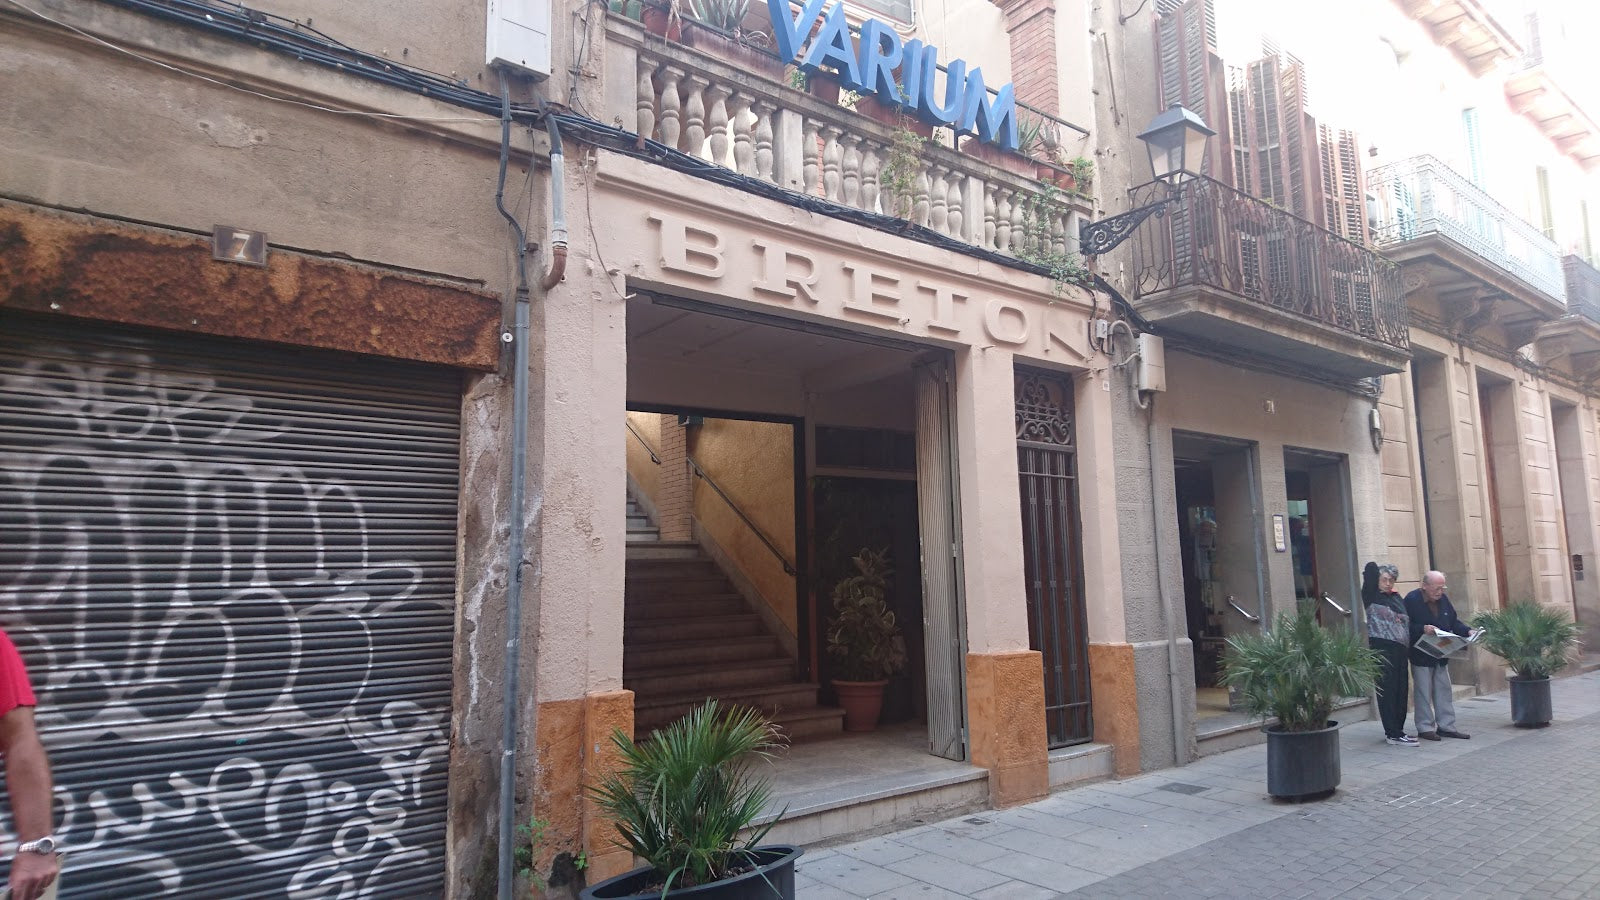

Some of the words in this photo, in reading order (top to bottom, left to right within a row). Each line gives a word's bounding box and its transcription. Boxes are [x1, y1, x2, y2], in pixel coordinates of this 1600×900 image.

[767, 0, 1019, 149] VARIUM
[232, 232, 250, 261] 7
[647, 210, 1087, 361] BRETON
